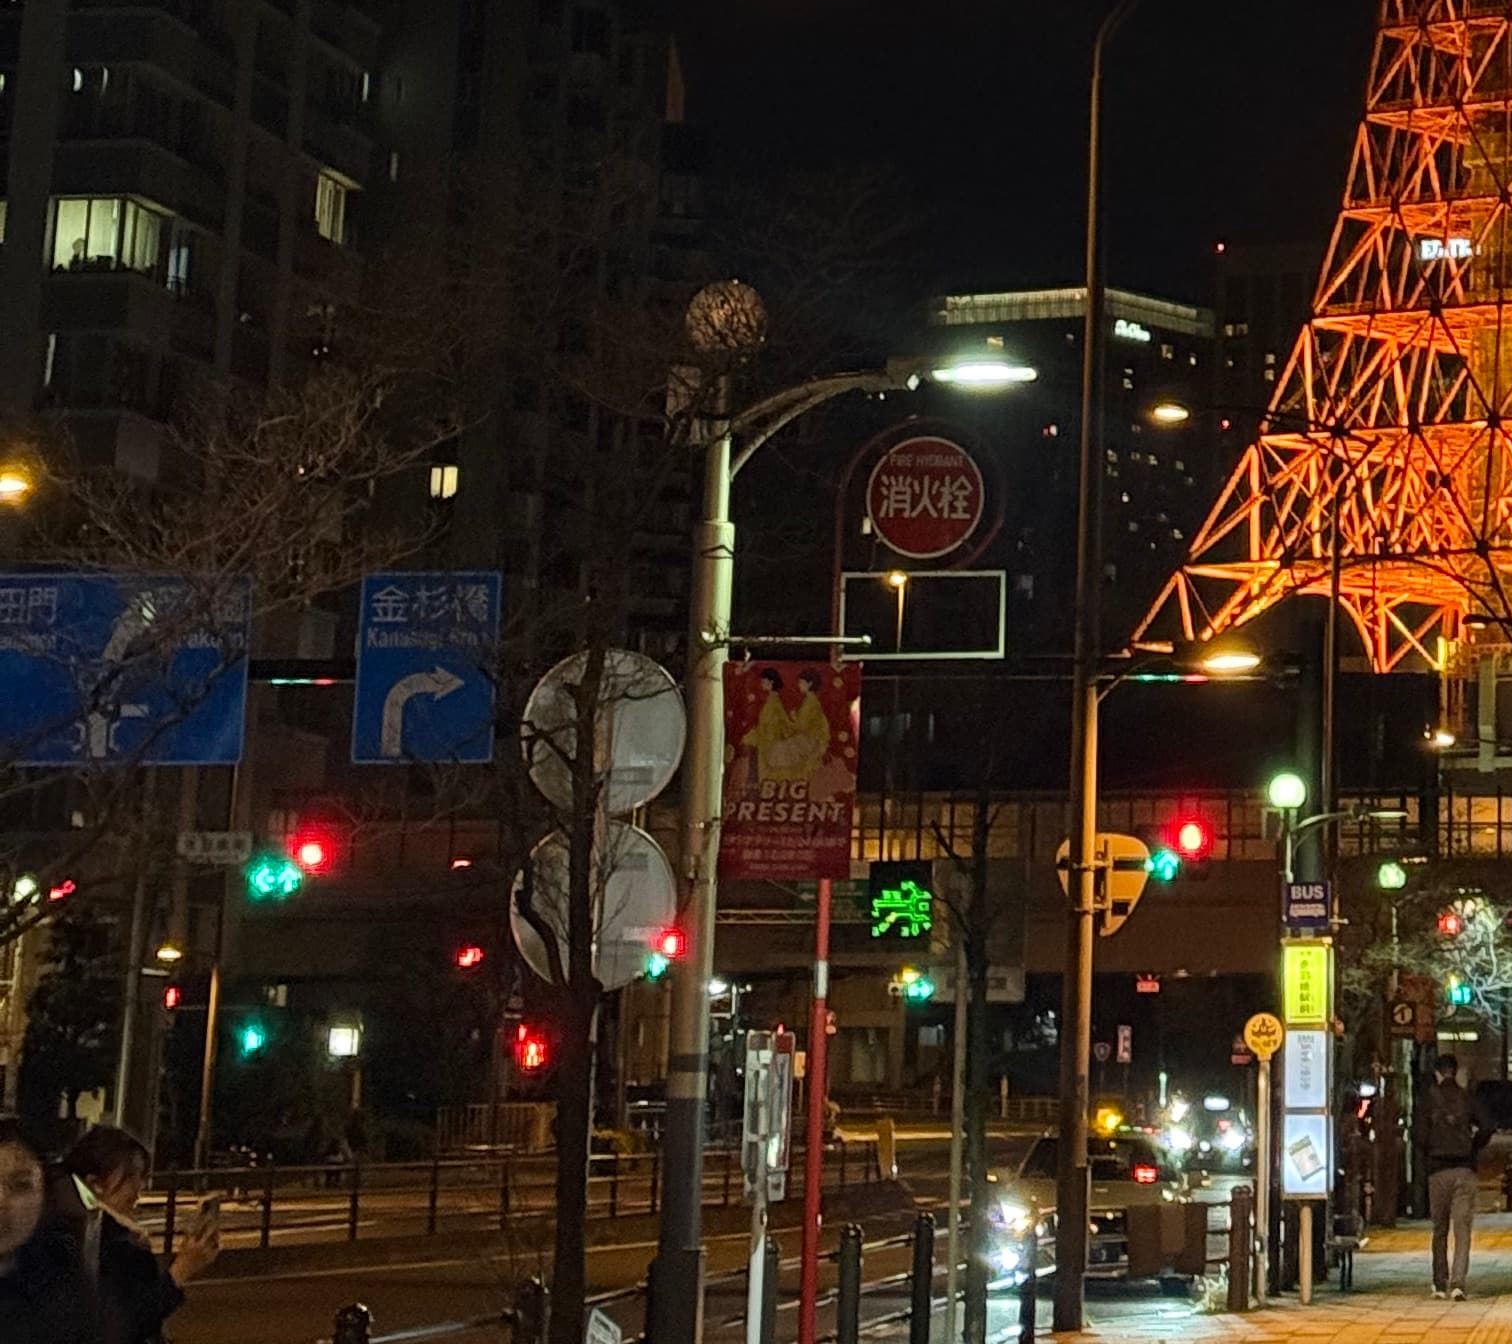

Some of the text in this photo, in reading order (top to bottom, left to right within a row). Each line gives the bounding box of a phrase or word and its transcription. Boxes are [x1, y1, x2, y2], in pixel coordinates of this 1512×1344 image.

[879, 475, 973, 519] 消火栓
[761, 779, 808, 800] BIG
[724, 800, 845, 822] PRESENT
[1290, 885, 1325, 900] BUS
